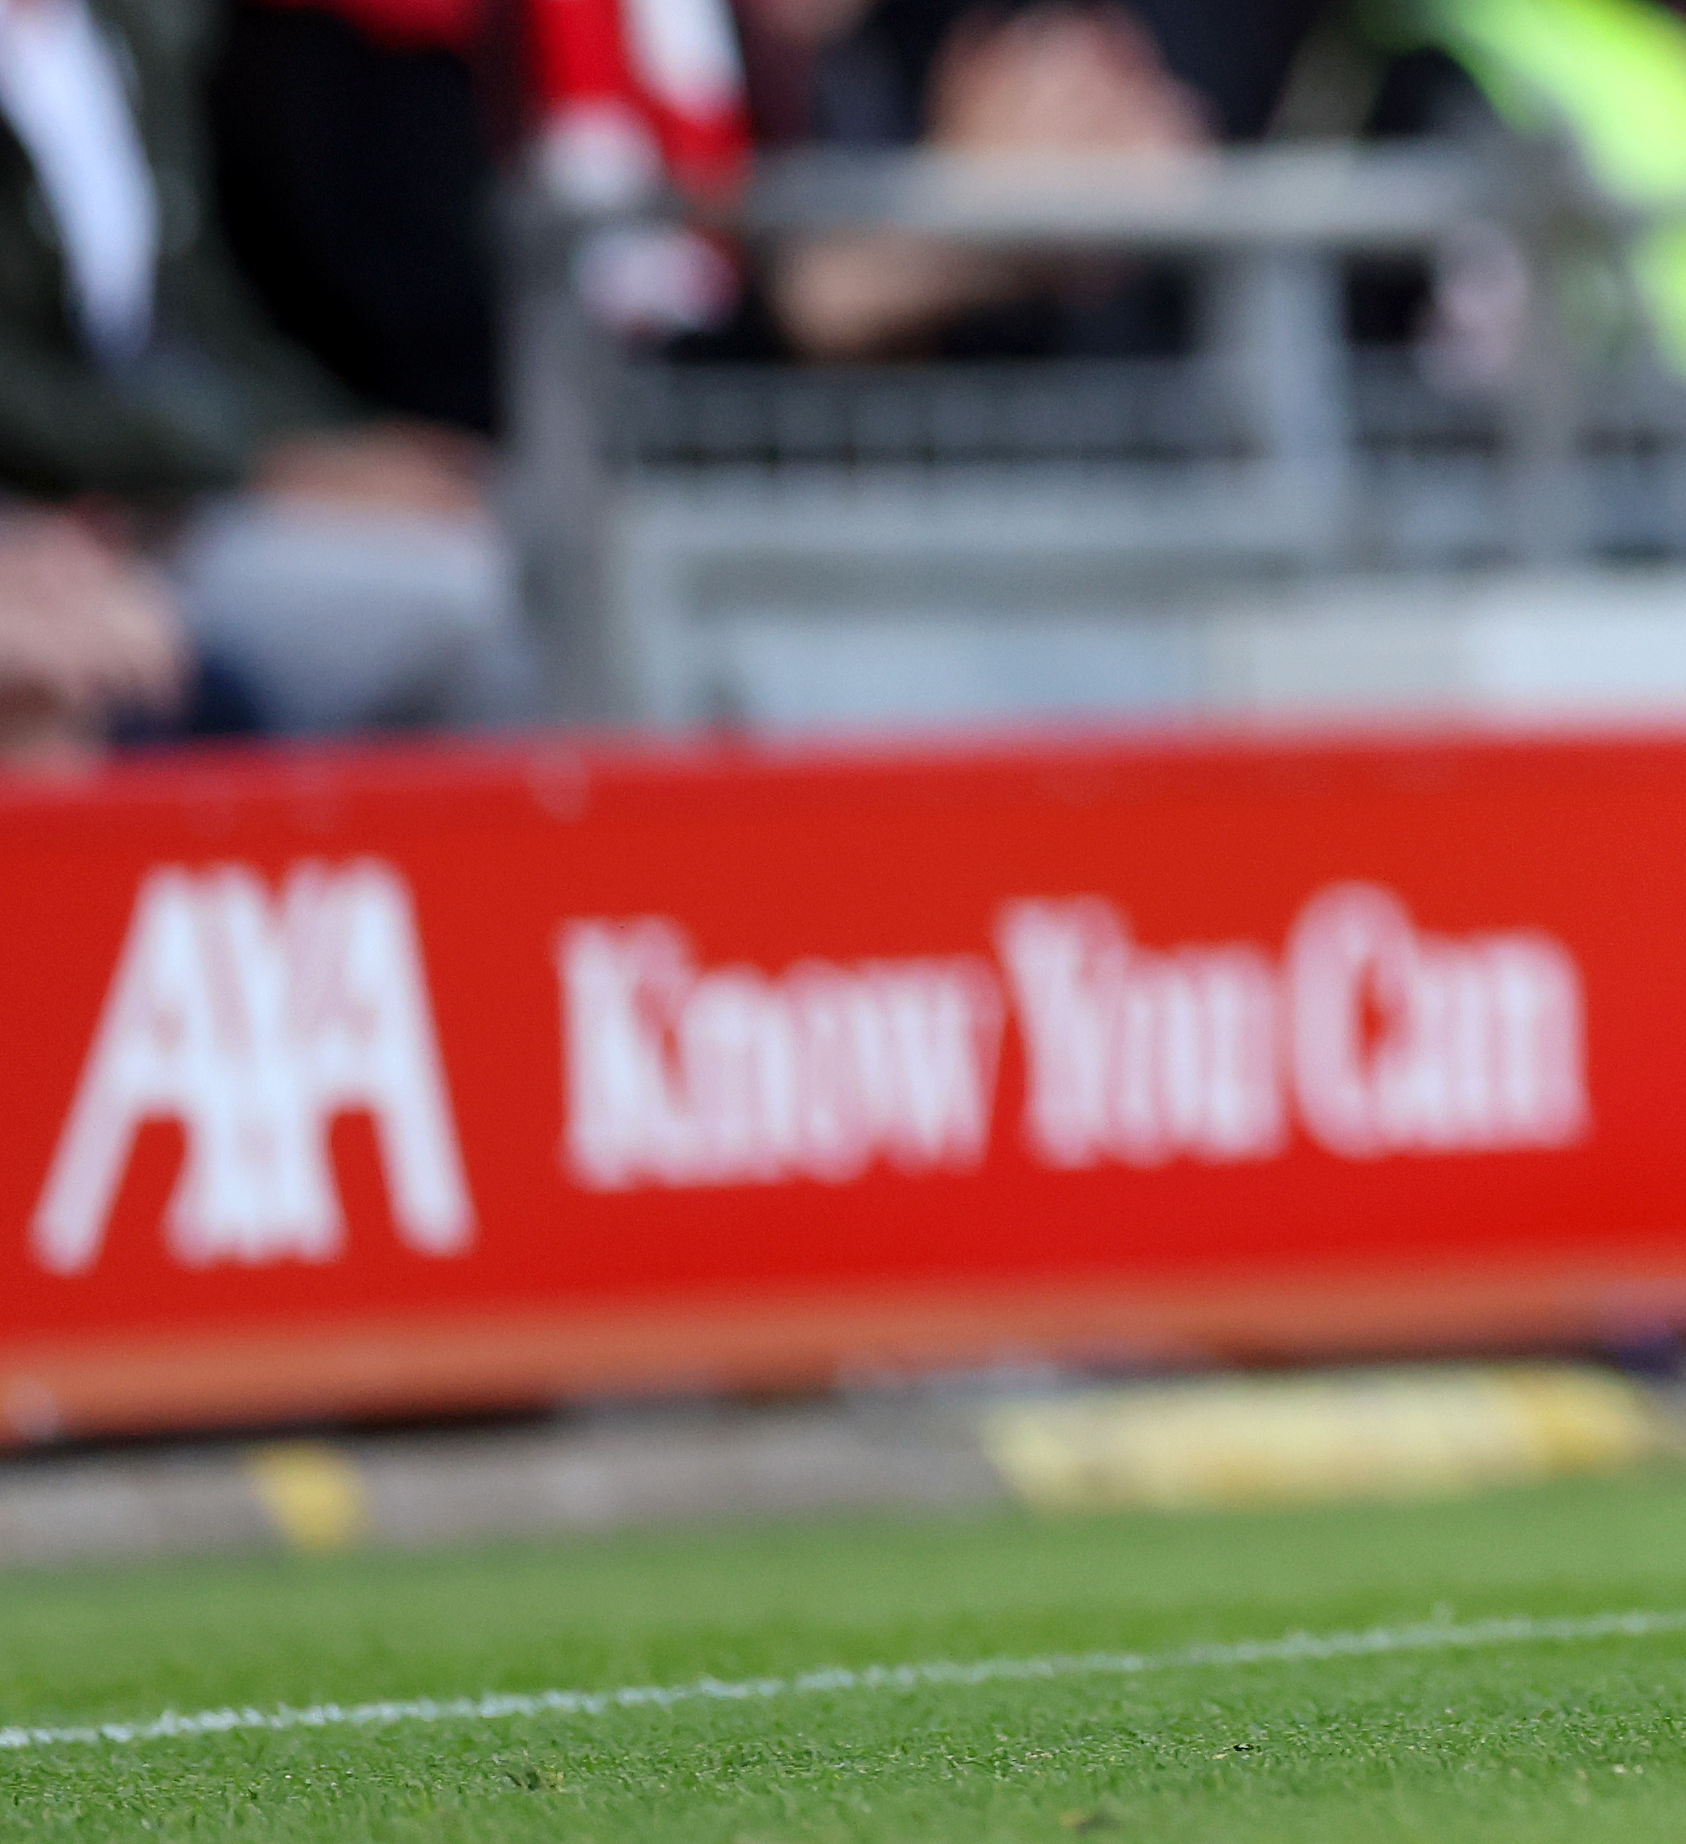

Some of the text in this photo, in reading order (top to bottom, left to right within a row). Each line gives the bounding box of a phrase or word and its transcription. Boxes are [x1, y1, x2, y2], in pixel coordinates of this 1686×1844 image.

[36, 862, 470, 1268] AXA
[561, 884, 1584, 1189] Know You Can
